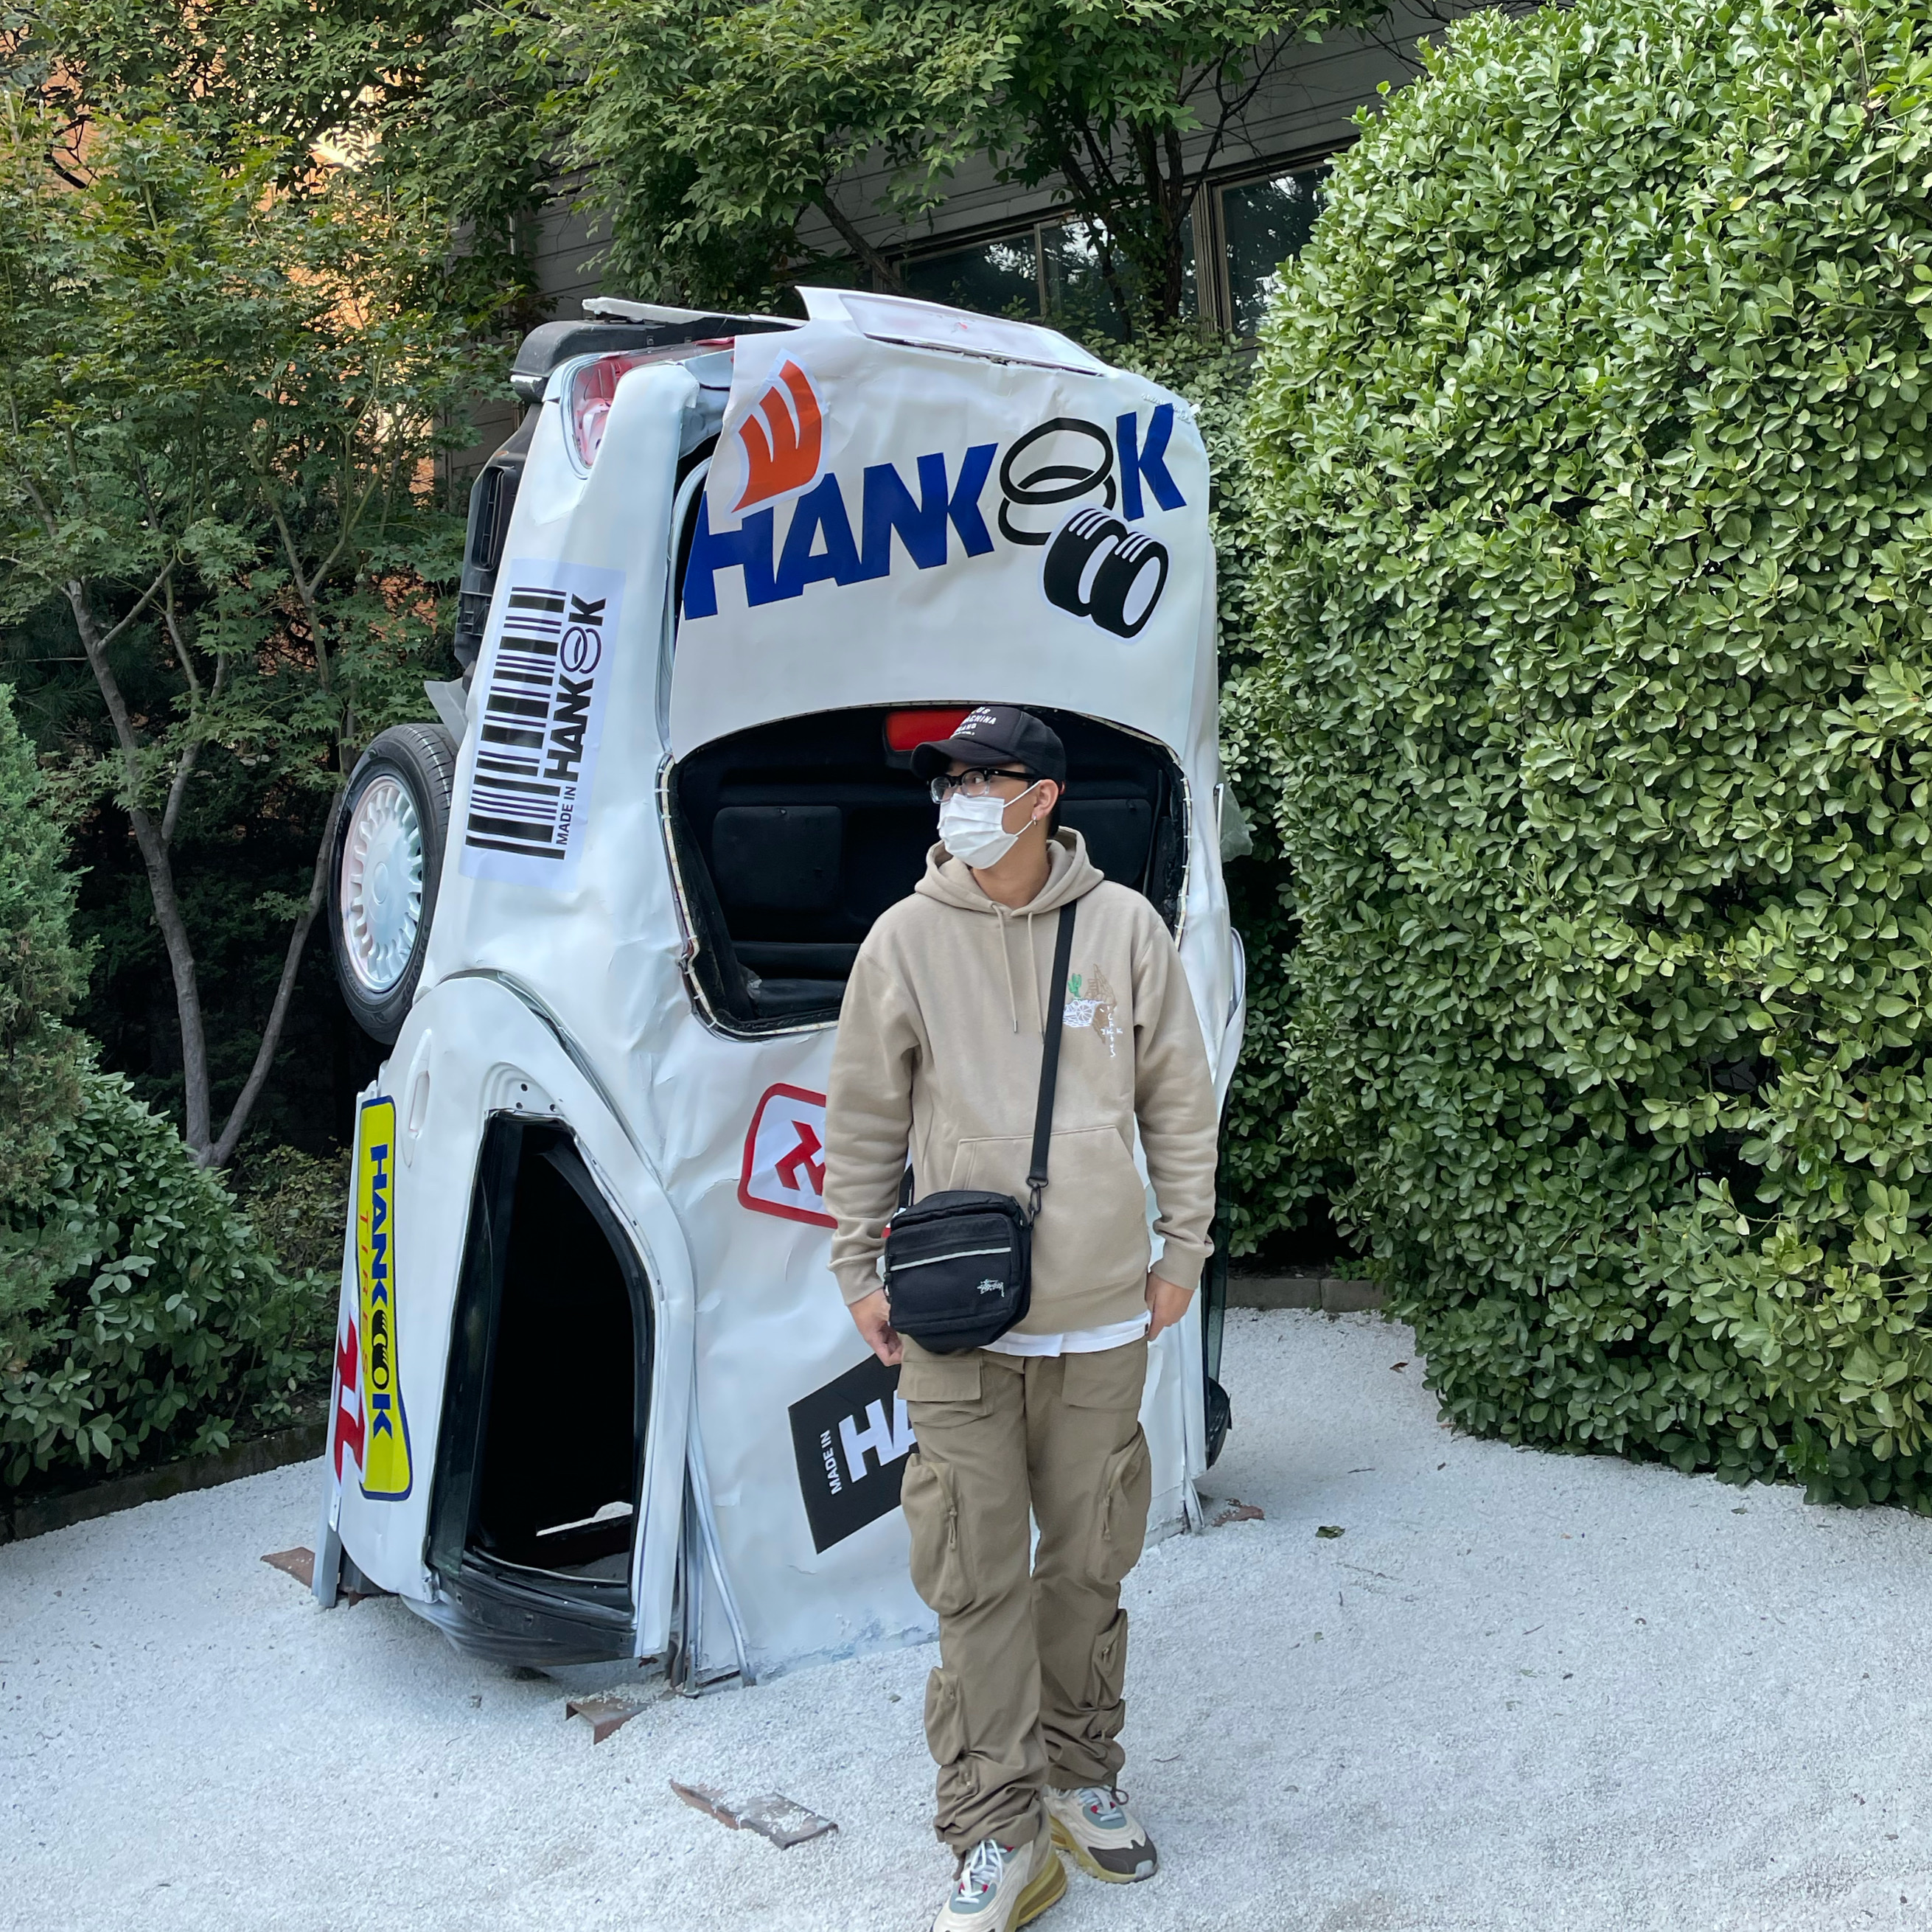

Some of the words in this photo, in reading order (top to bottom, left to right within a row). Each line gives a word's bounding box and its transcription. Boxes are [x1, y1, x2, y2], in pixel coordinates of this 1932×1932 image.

[683, 403, 1187, 621] HANKOOK
[543, 593, 607, 782] HANKOOK
[556, 803, 573, 845] MADE
[563, 786, 577, 801] IN
[360, 1210, 369, 1375] TIRES
[370, 1144, 393, 1440] HANKOOK
[820, 1429, 831, 1449] IN
[823, 1448, 843, 1495] MADE
